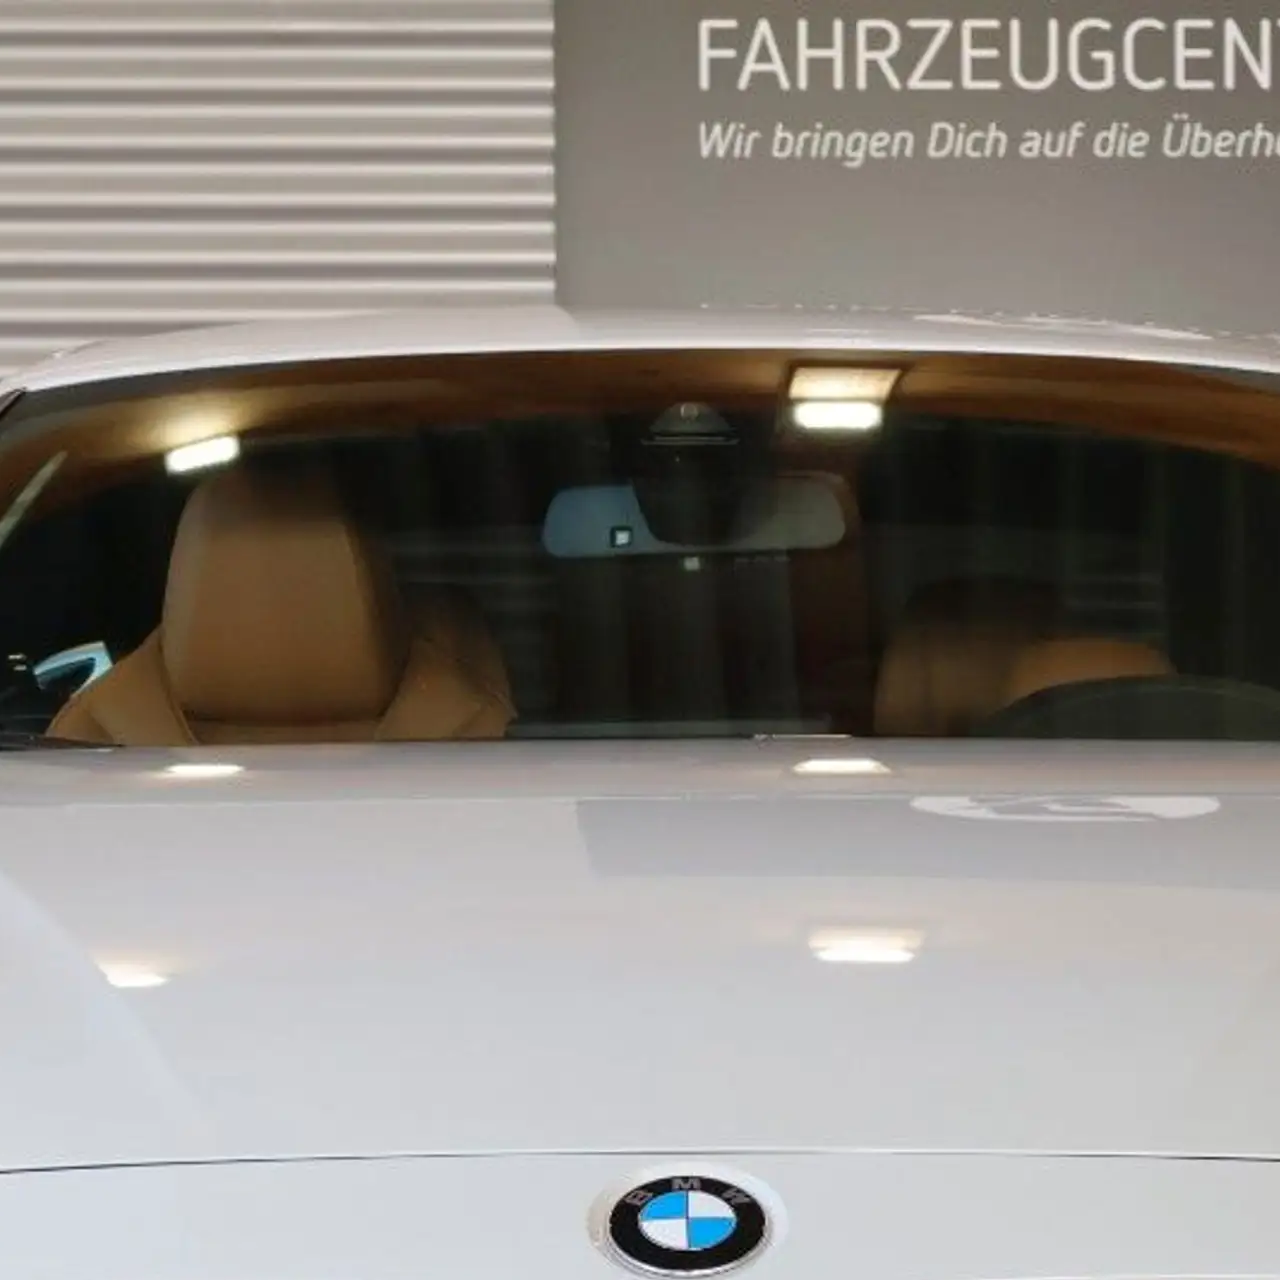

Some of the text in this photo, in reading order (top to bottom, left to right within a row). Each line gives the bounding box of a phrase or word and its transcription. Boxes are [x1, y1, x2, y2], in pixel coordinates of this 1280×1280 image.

[699, 121, 761, 159] Wir
[772, 121, 914, 168] bringen
[927, 121, 1008, 159] Dich
[1019, 121, 1084, 159] auf
[1093, 120, 1150, 158] die
